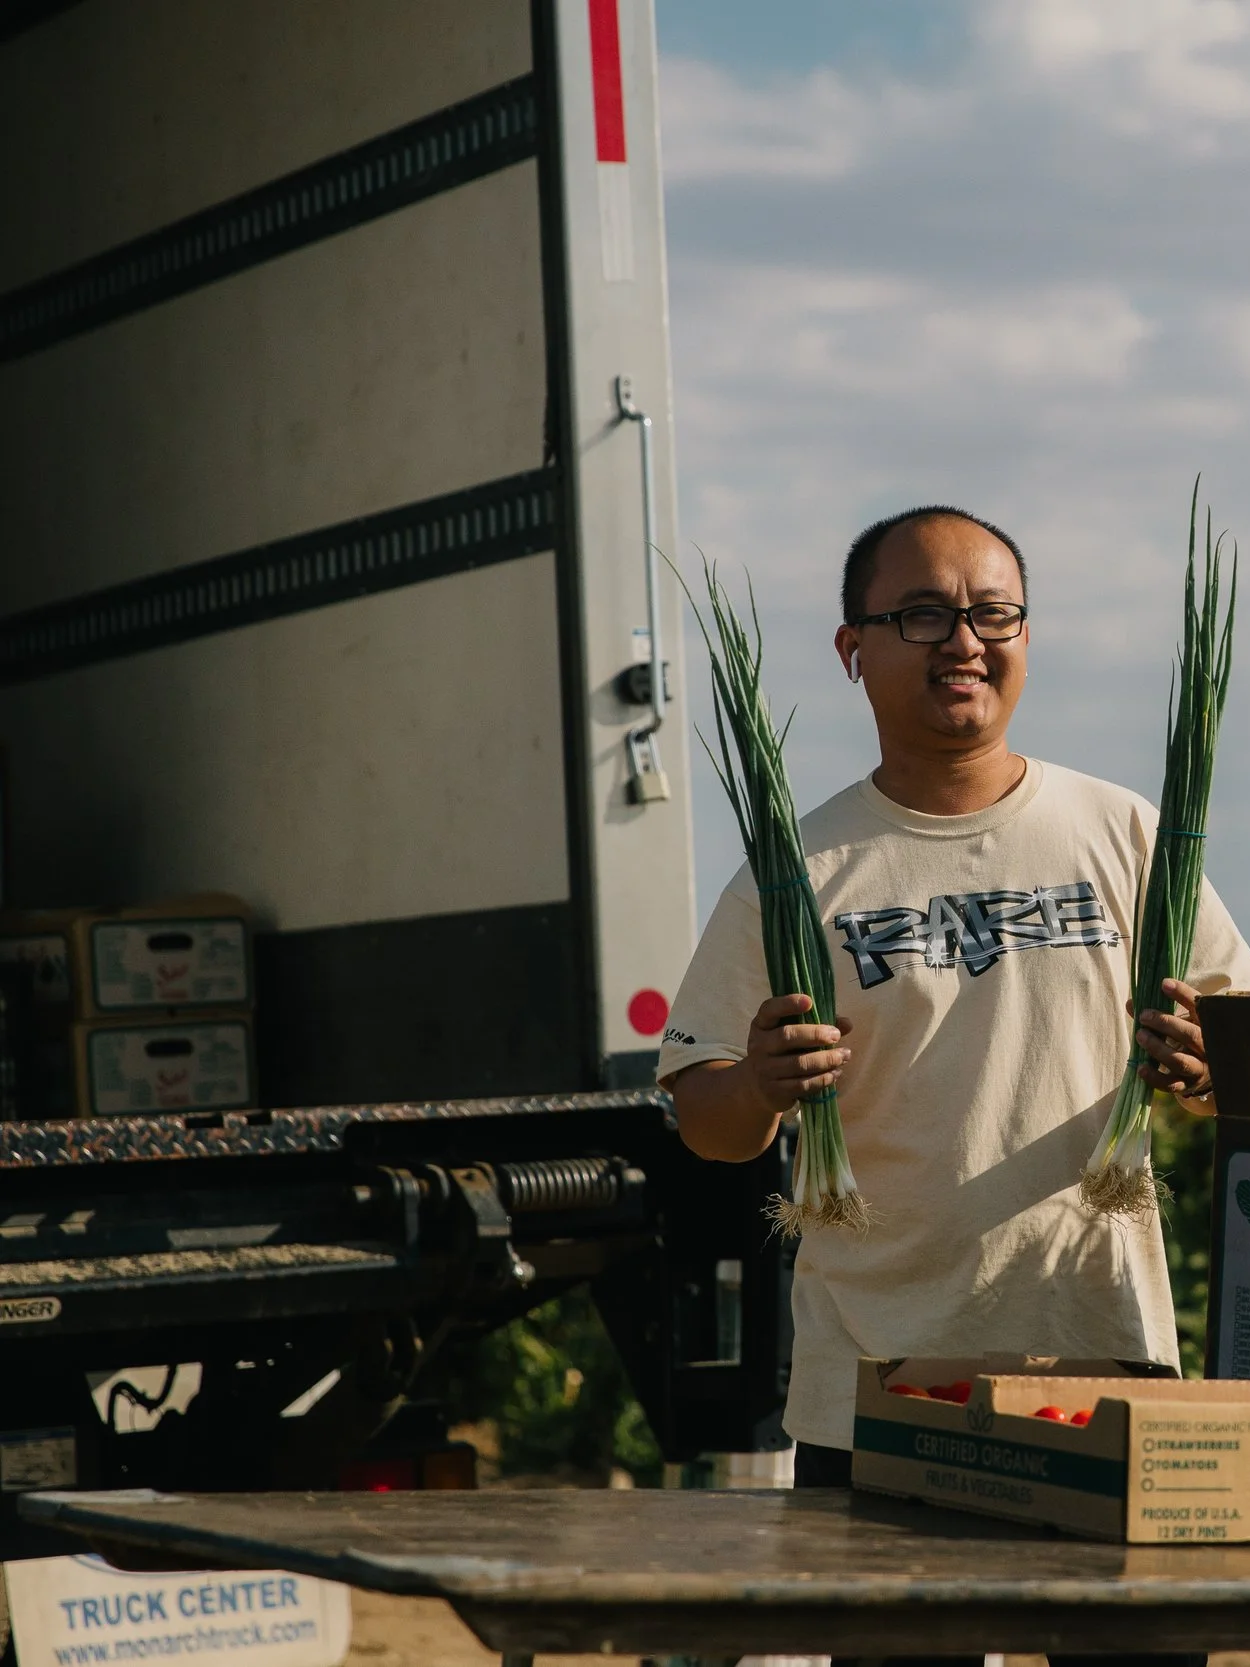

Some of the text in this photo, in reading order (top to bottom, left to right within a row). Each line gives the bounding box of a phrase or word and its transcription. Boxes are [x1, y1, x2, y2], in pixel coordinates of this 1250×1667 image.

[1155, 1439, 1240, 1450] STRAWBERRIES
[914, 1431, 1050, 1477] CERTIFIED ORGANIC
[1153, 1460, 1217, 1470] TOMATOES
[1141, 1508, 1242, 1519] PRODUCE OF U.S.A.
[60, 1578, 299, 1630] TRUCK CENTER
